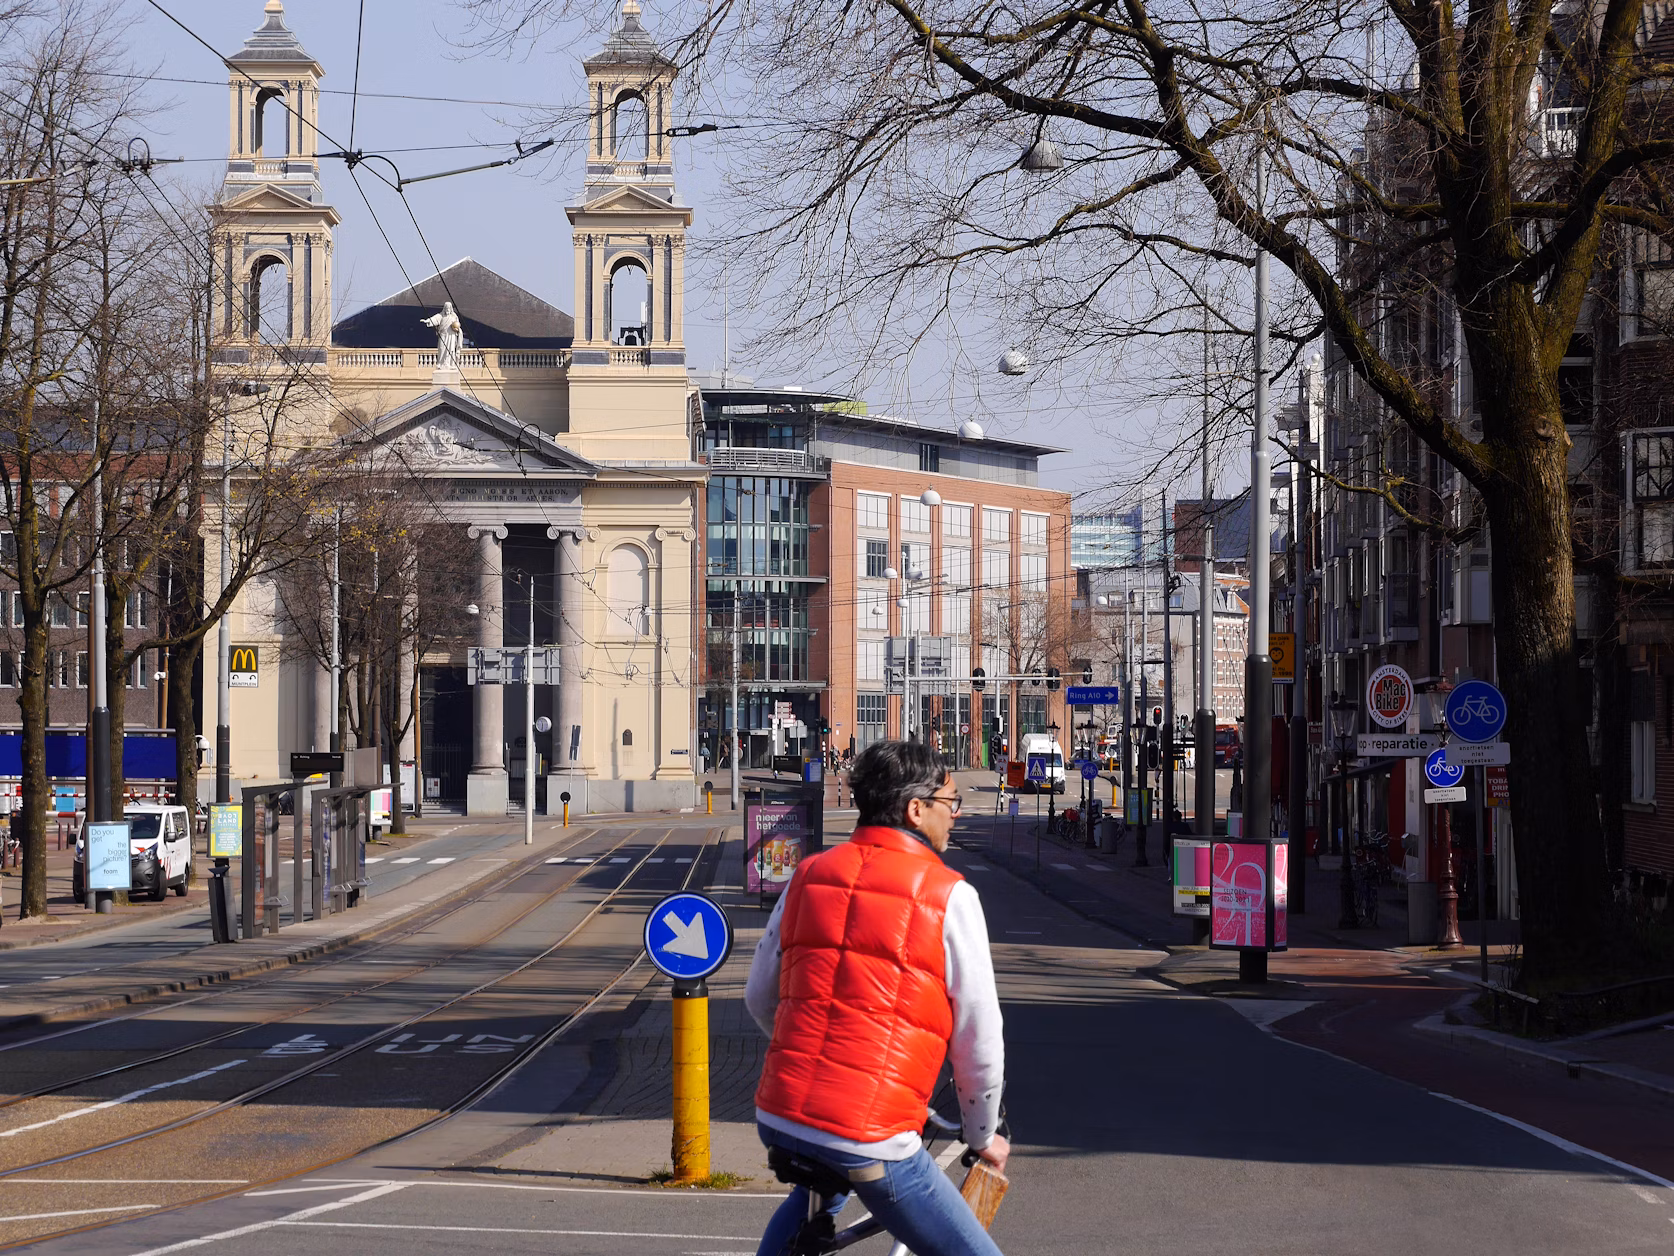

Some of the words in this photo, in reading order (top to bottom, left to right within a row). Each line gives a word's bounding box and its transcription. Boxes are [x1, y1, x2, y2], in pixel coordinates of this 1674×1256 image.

[1375, 667, 1407, 680] AMSTERDAM
[1383, 679, 1406, 696] Mac
[1069, 692, 1086, 700] Ring
[1376, 693, 1399, 710] Bike
[1372, 710, 1384, 723] CITY
[1394, 711, 1408, 724] BIKES
[1372, 737, 1428, 752] reparatie
[755, 814, 781, 822] meer
[756, 821, 773, 831] het
[772, 821, 801, 831] goede
[91, 836, 103, 844] get
[107, 848, 127, 856] bigger
[103, 855, 127, 864] picture?
